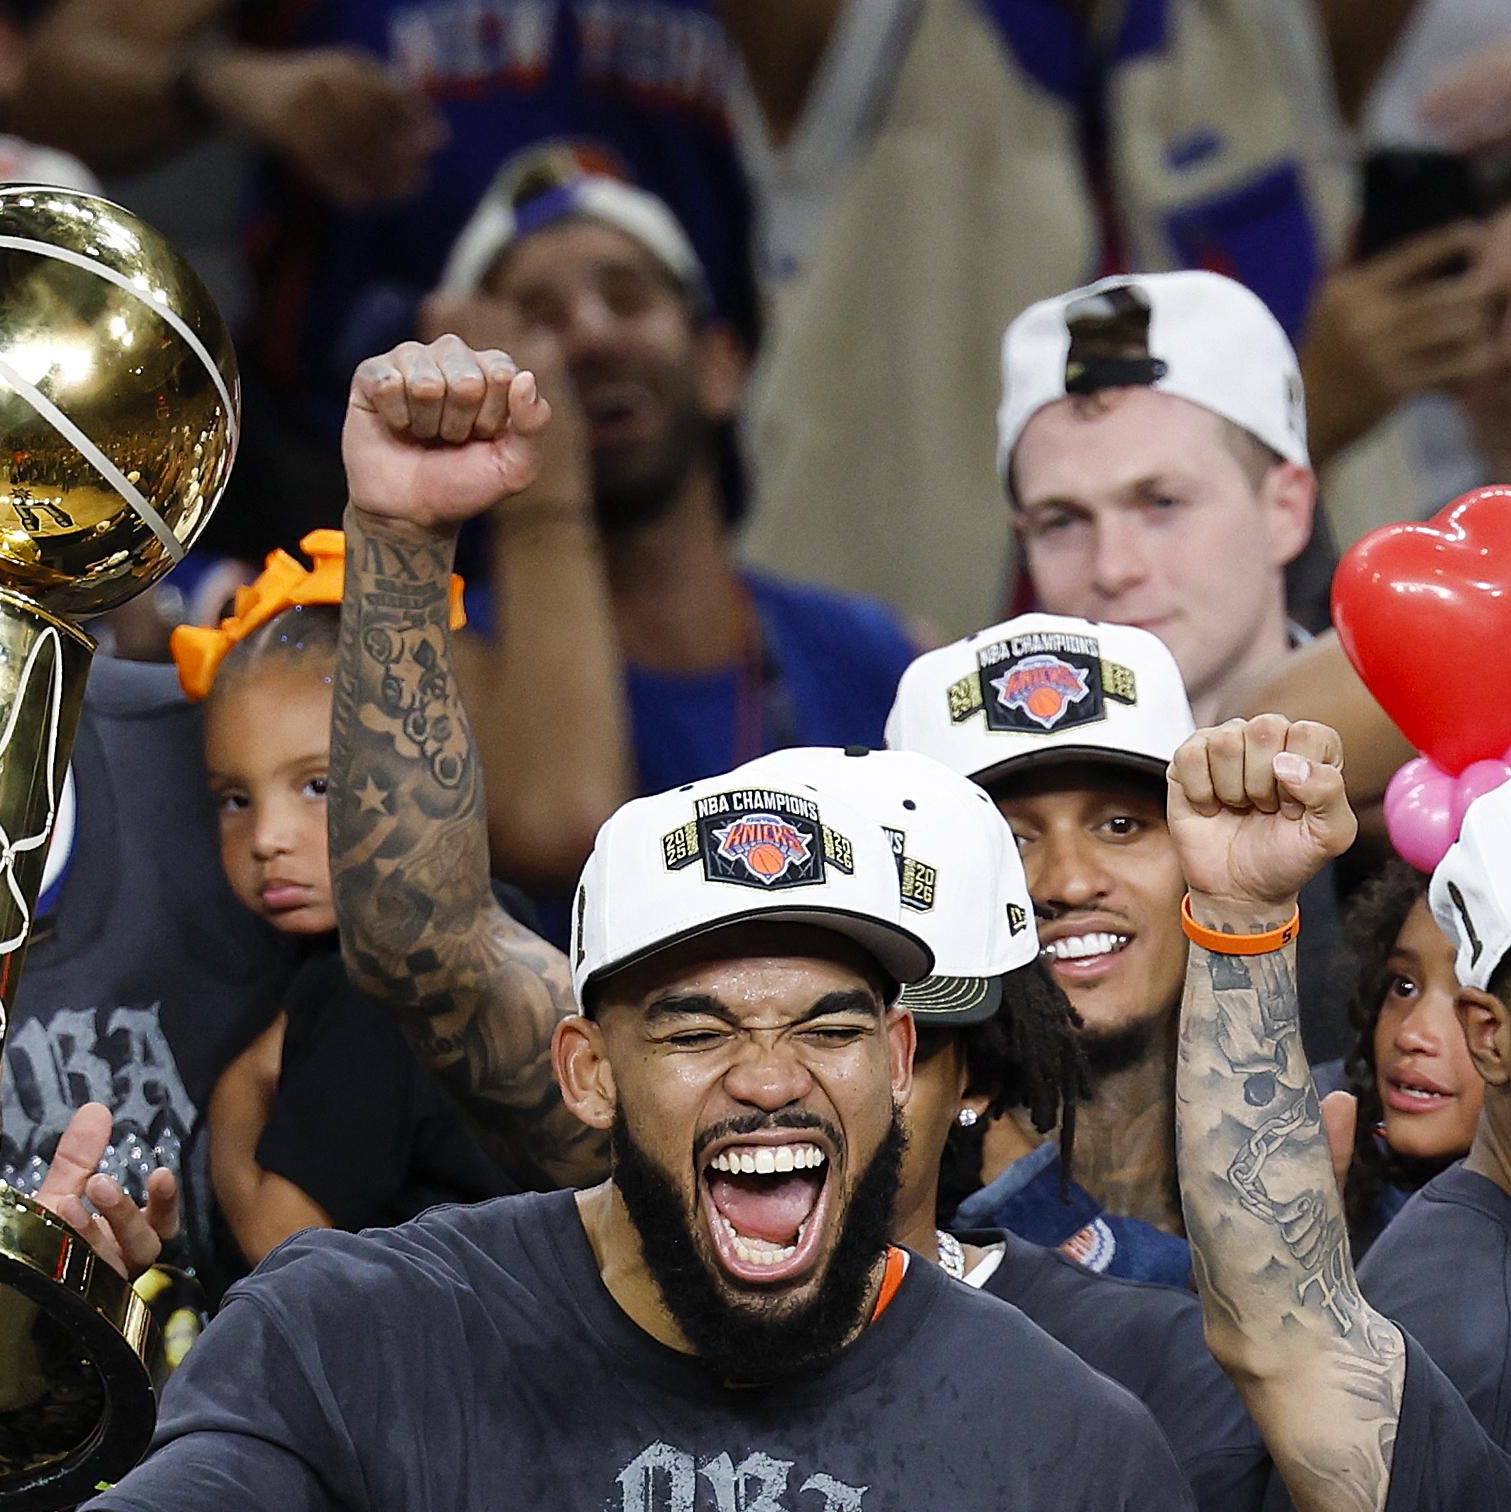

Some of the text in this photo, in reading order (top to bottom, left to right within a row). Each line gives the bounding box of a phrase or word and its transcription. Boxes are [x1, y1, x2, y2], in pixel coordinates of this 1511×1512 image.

[697, 790, 819, 821] NBA CHAMPIONS
[666, 829, 685, 850] 20
[723, 822, 806, 854] KNICKS
[833, 832, 851, 852] 20
[666, 846, 687, 866] 25
[836, 848, 853, 869] 26
[915, 863, 935, 886] 20
[914, 882, 933, 904] 26
